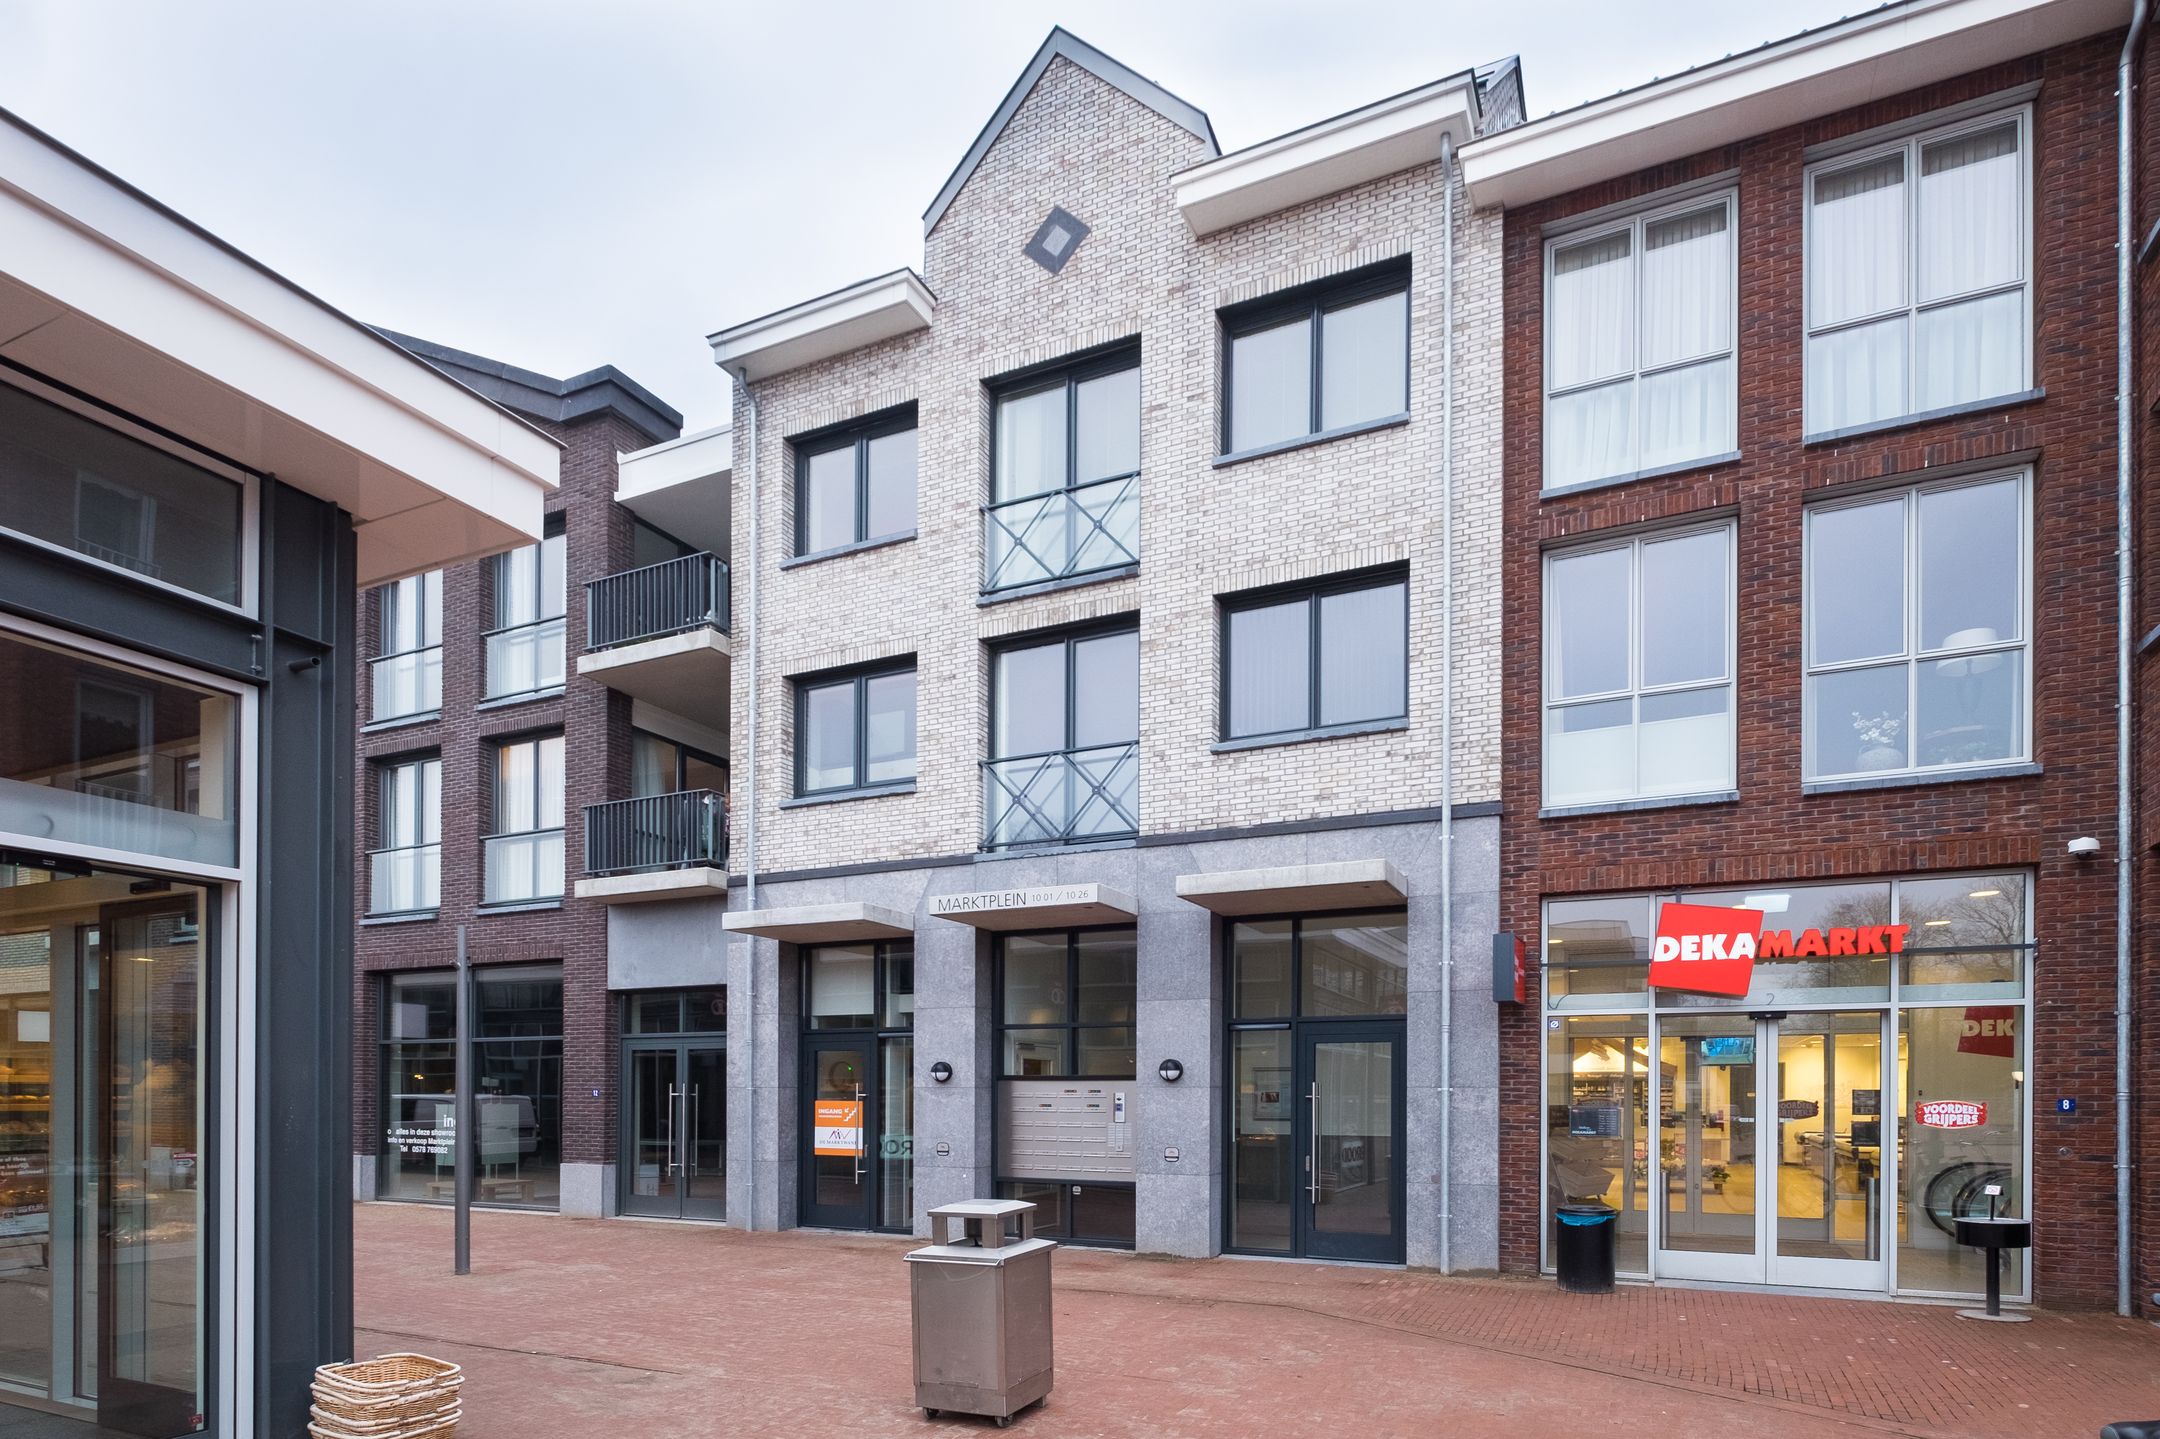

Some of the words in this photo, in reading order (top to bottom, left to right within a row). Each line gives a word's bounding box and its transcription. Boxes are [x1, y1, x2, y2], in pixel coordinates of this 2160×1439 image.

[938, 892, 1027, 912] MARKTPLEIN
[1078, 889, 1089, 899] 26
[1923, 1103, 1980, 1114] VOORDEEL
[2062, 1099, 2070, 1110] 8
[443, 1114, 456, 1128] in
[1923, 1113, 1979, 1128] GRIJPERS
